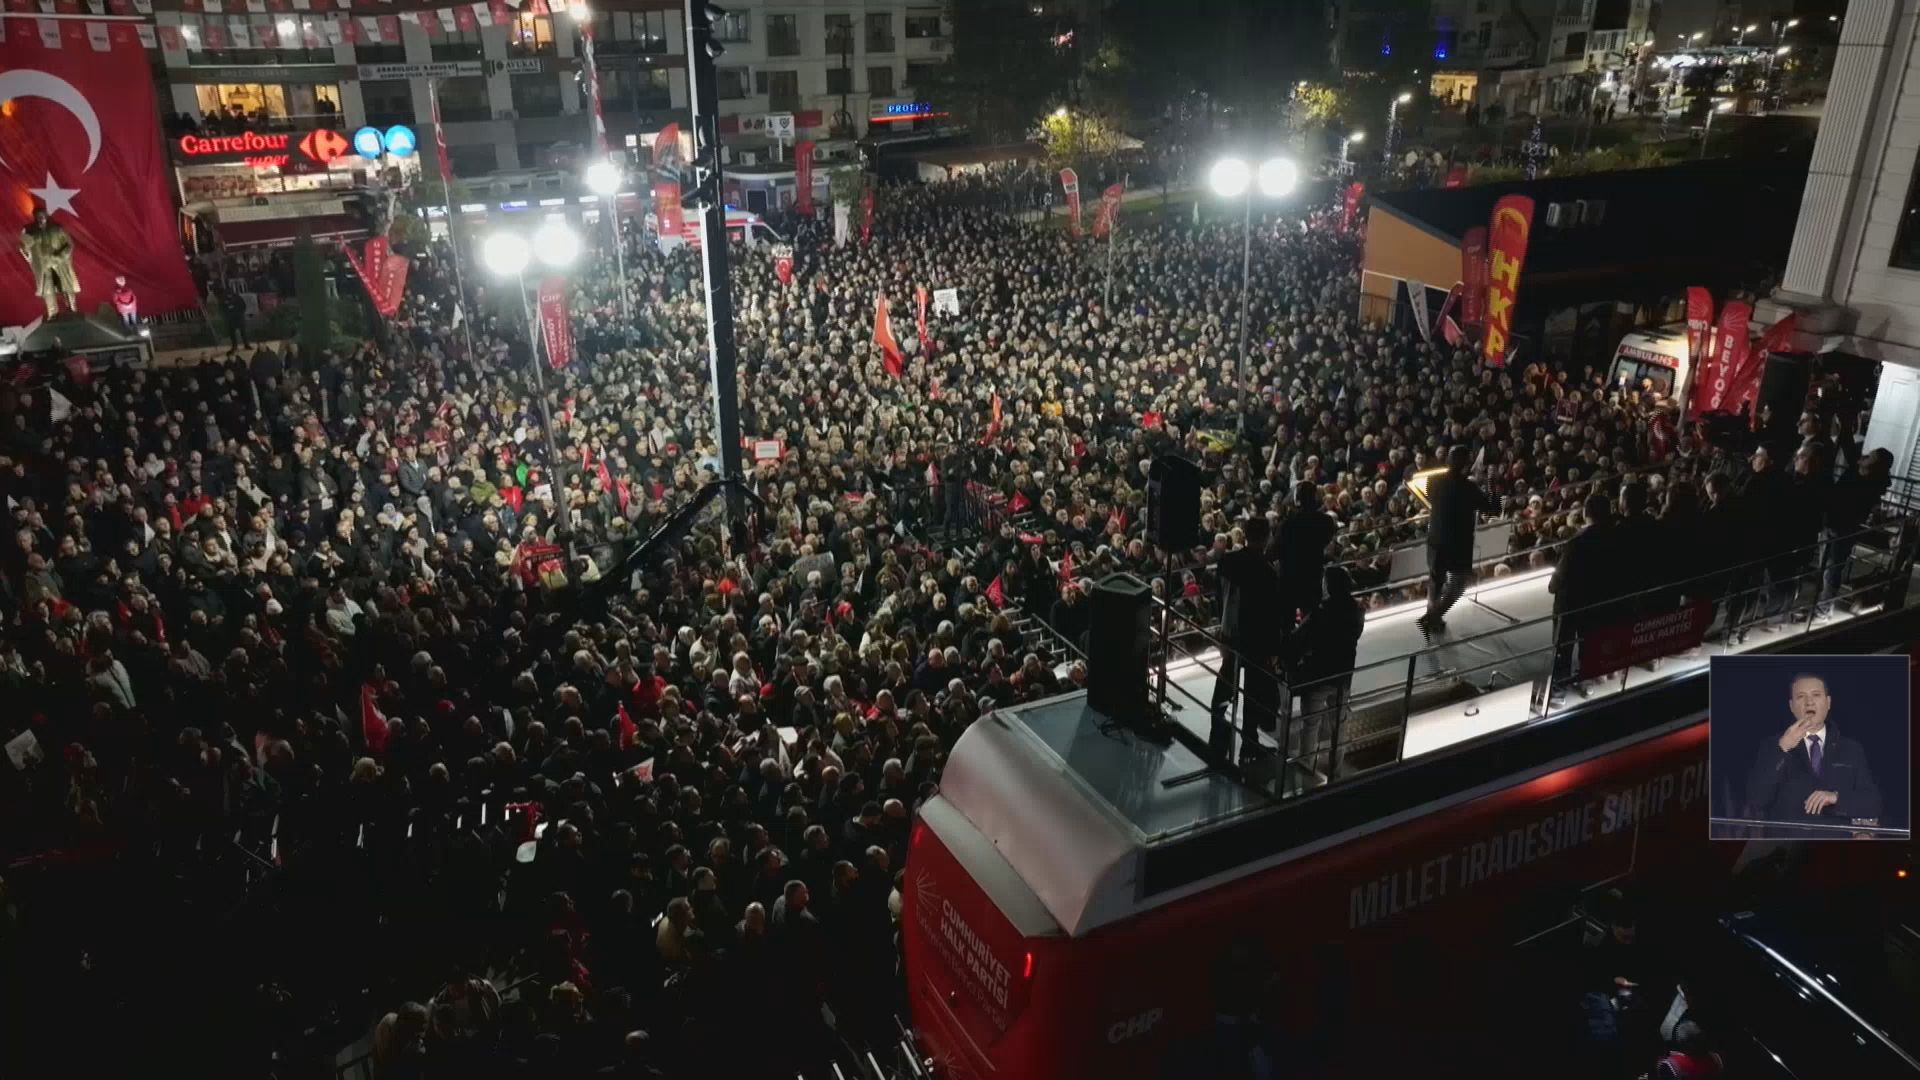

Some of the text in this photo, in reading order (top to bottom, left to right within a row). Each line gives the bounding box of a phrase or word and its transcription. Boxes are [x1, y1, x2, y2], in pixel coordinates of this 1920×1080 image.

[180, 131, 288, 154] Carrefour
[244, 154, 289, 169] super
[1622, 346, 1673, 366] AMBULANS
[943, 899, 1011, 987] CUMHURİYET
[941, 916, 1008, 1009] HALK PARTİSİ
[1108, 1008, 1164, 1044] CHP
